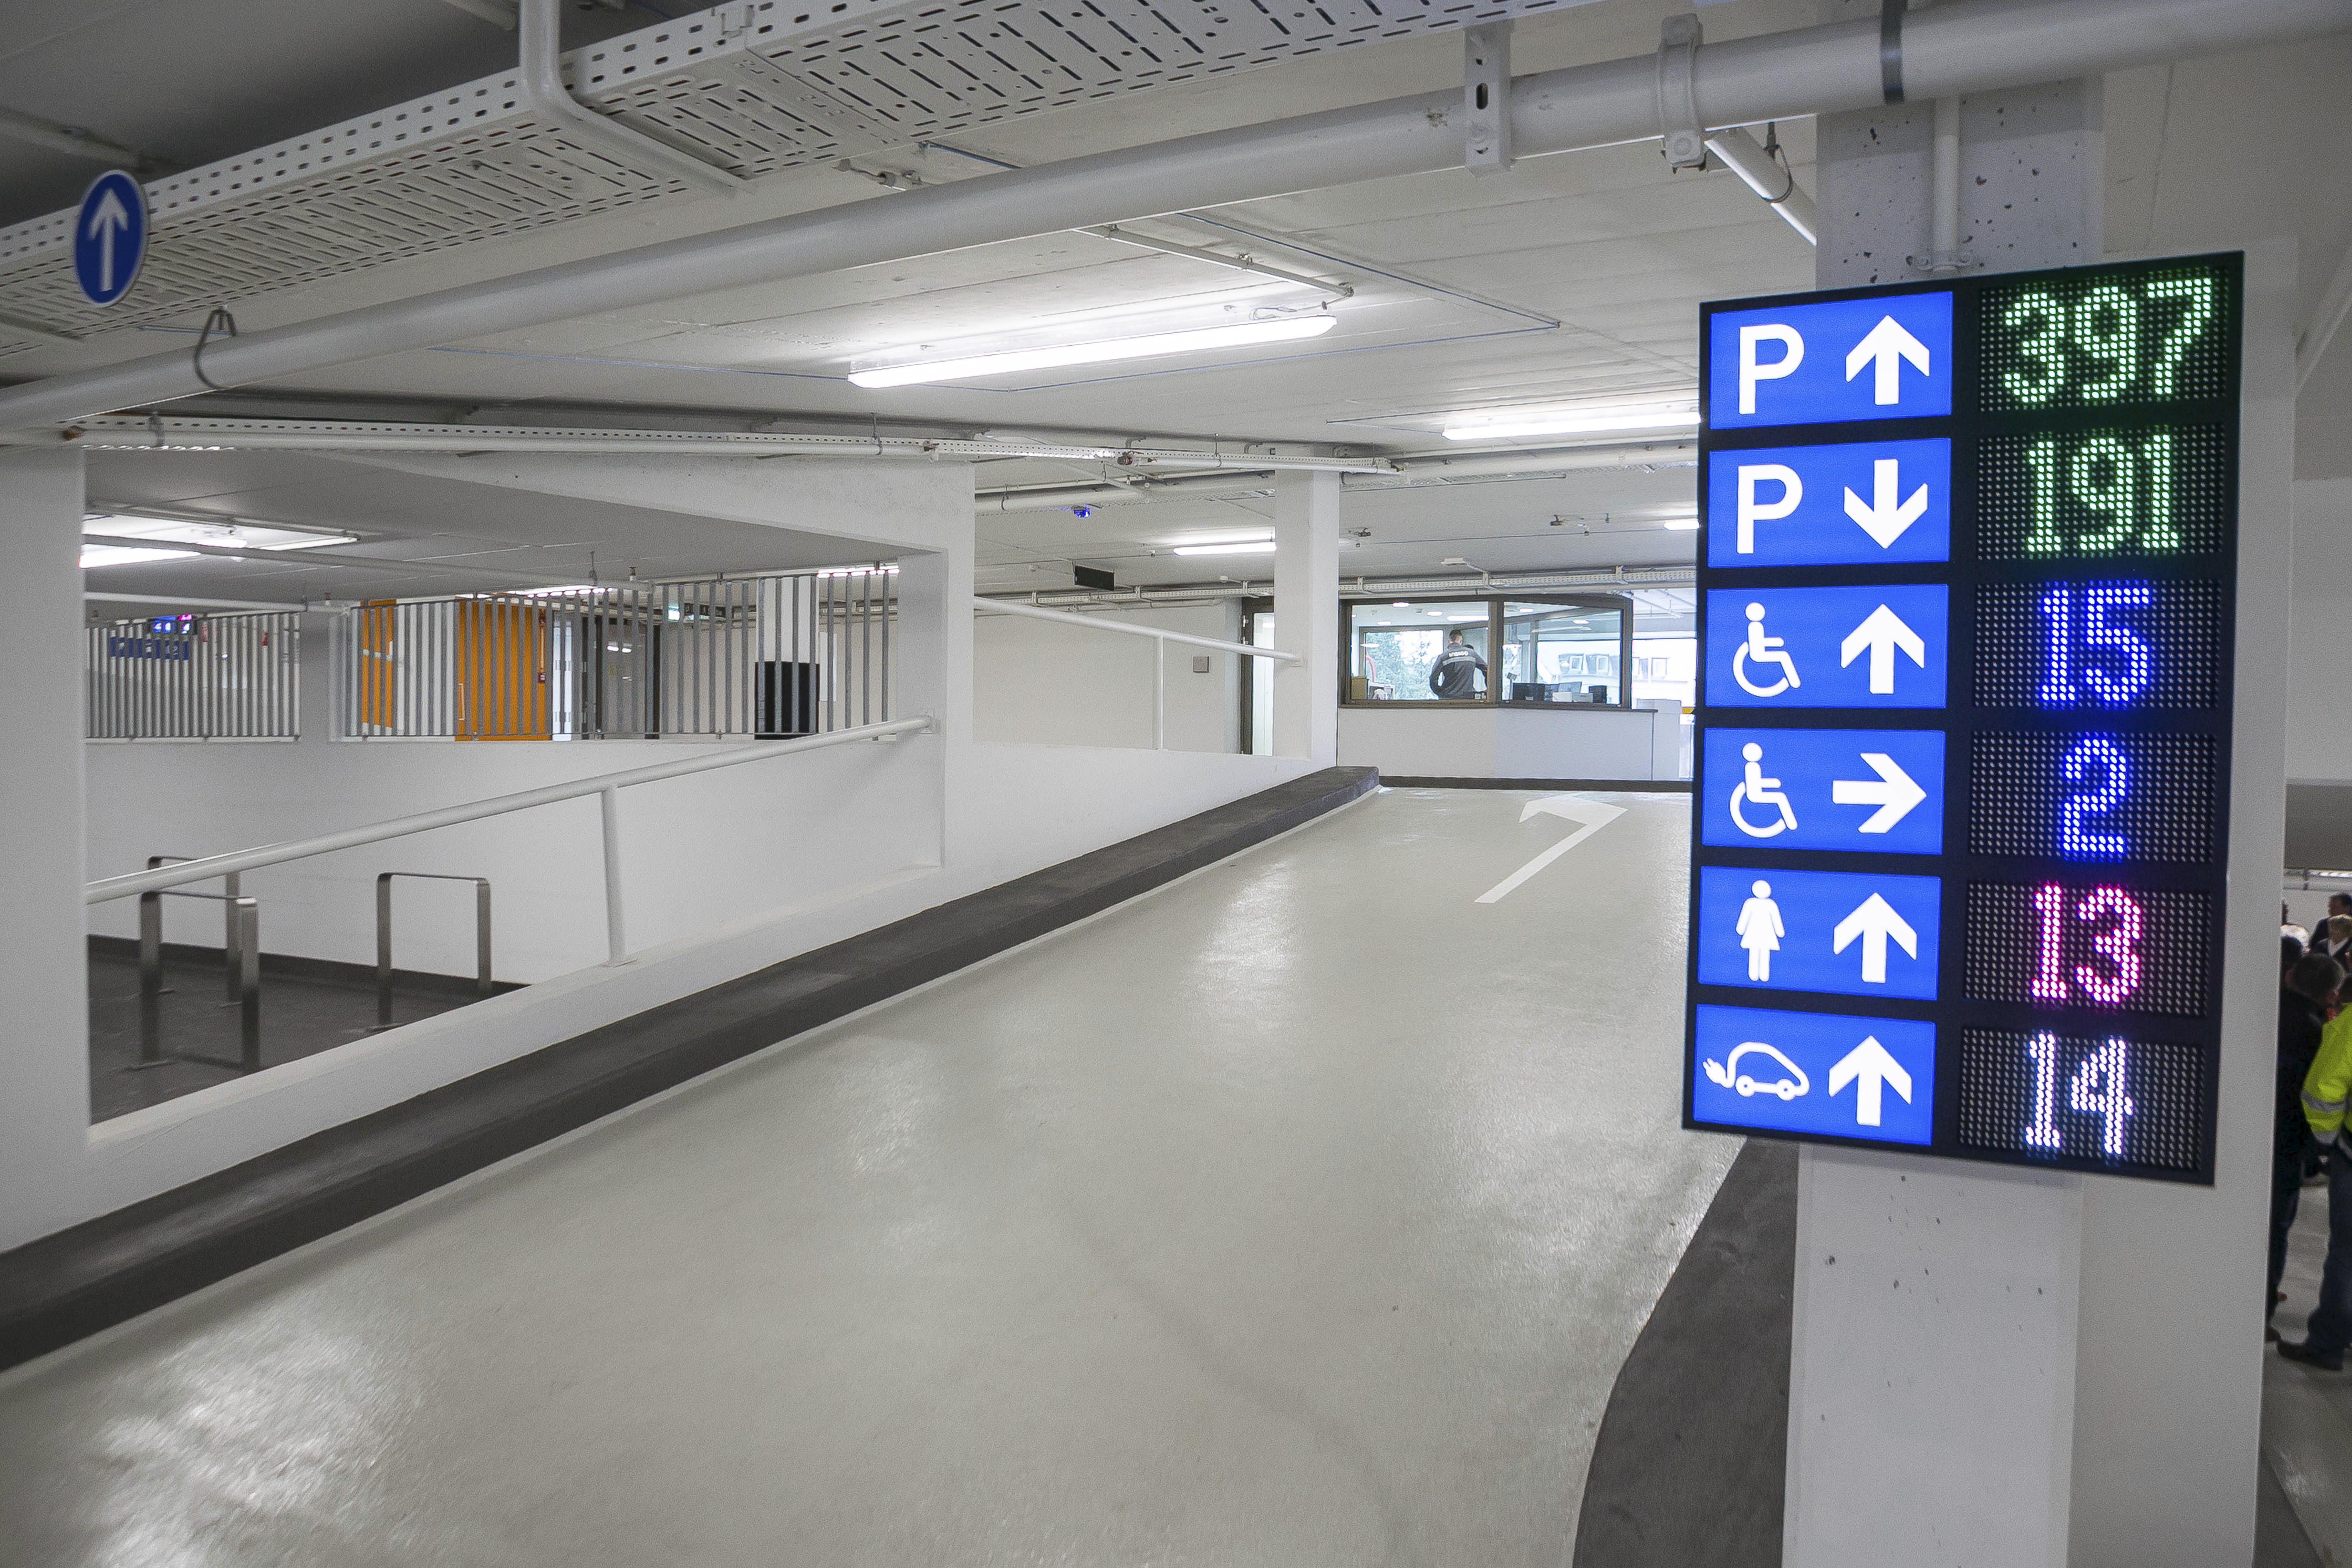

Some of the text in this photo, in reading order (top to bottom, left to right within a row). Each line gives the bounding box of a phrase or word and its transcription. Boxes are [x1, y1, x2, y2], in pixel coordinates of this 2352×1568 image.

[1738, 277, 2213, 415] P 397
[1737, 433, 2179, 555] P 191
[2040, 586, 2152, 703] 15
[2060, 737, 2127, 855] 2
[2031, 884, 2142, 1004] 13
[2025, 1032, 2134, 1155] 14
